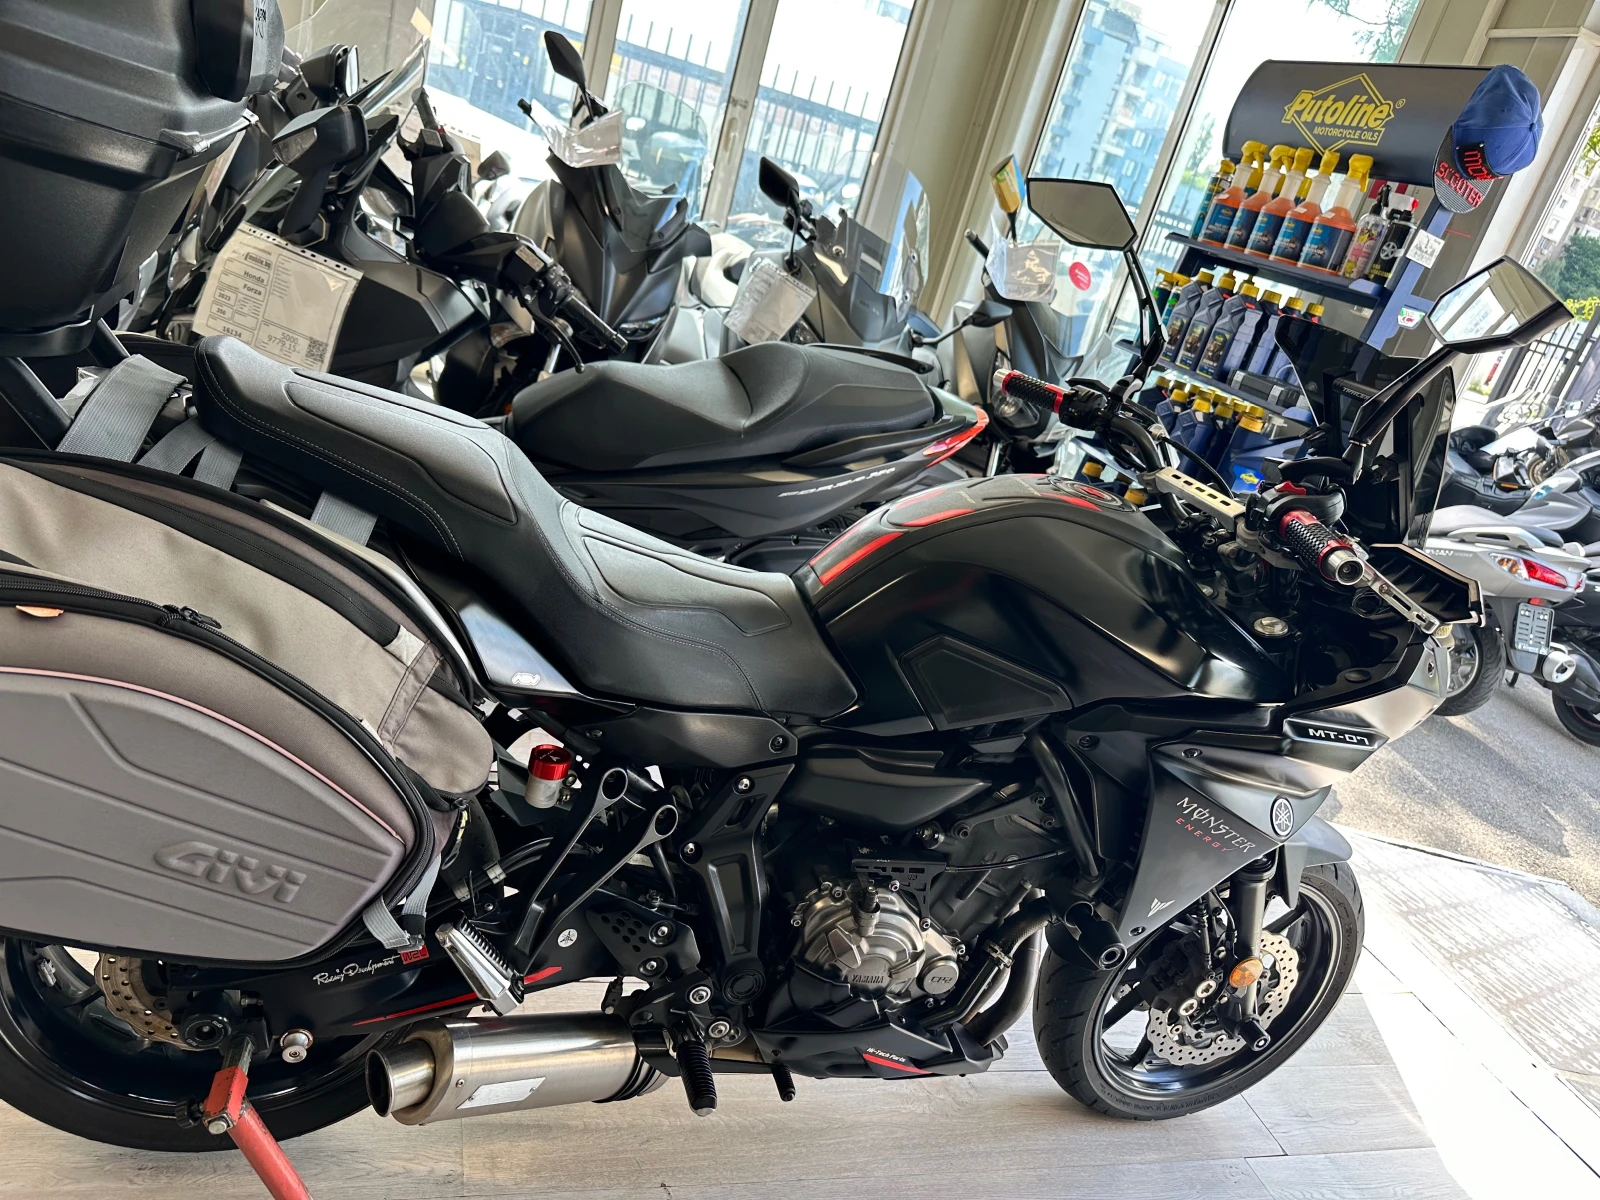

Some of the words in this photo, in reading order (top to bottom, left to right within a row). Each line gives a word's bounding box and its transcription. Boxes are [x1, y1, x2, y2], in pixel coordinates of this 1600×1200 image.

[1285, 91, 1390, 128] Putoline
[1313, 126, 1361, 139] MOTORCYCLE
[1361, 130, 1379, 141] OILS
[1434, 161, 1484, 208] SCOOTER
[243, 270, 266, 284] Honda
[243, 284, 263, 296] Forza
[1308, 728, 1370, 746] MT-07
[1175, 817, 1234, 852] ENERGY
[852, 974, 885, 984] YAMAHA
[931, 976, 953, 984] CP2
[866, 1047, 890, 1059] Hi-Tech
[889, 1054, 907, 1063] Parts
